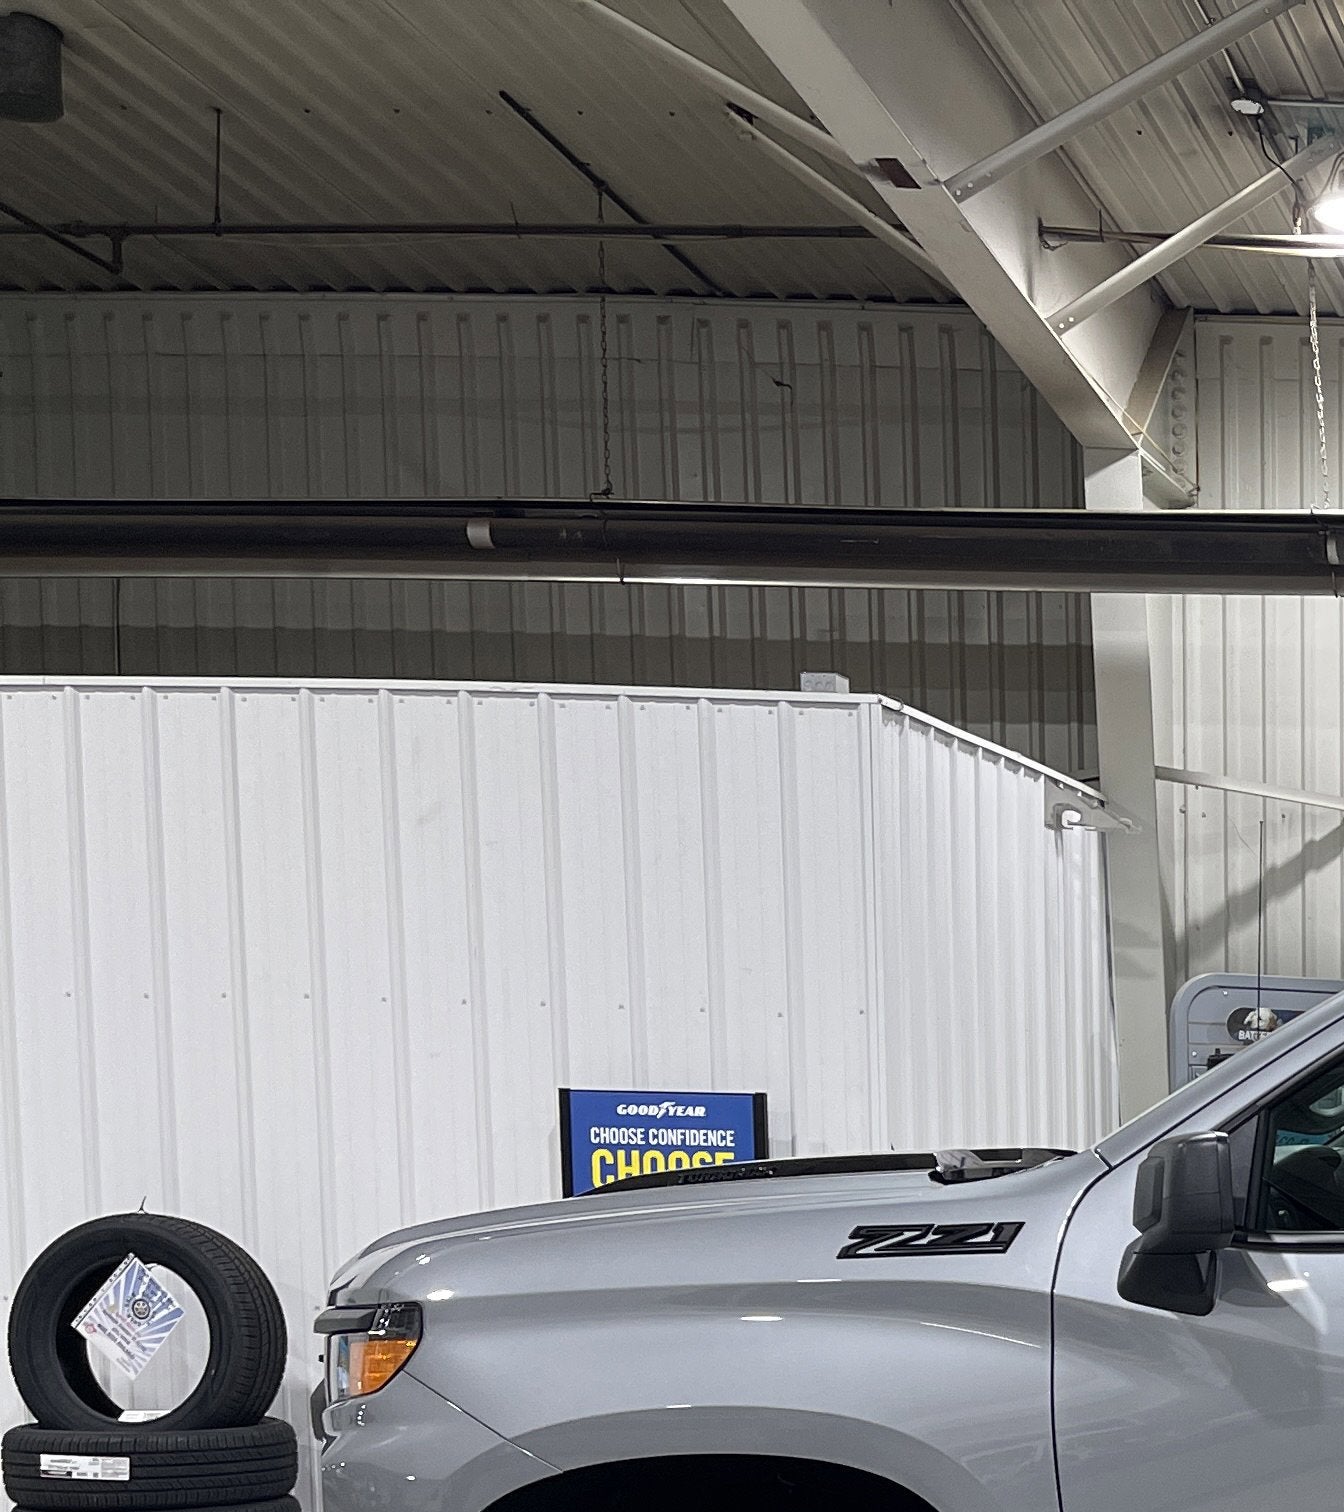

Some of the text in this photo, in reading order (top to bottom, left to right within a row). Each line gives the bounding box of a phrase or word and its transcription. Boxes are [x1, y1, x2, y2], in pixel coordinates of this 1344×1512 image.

[616, 1101, 706, 1119] GOODYEAR
[590, 1126, 735, 1147] CHOOSE CONFIDENCE
[836, 1222, 1026, 1259] Z71
